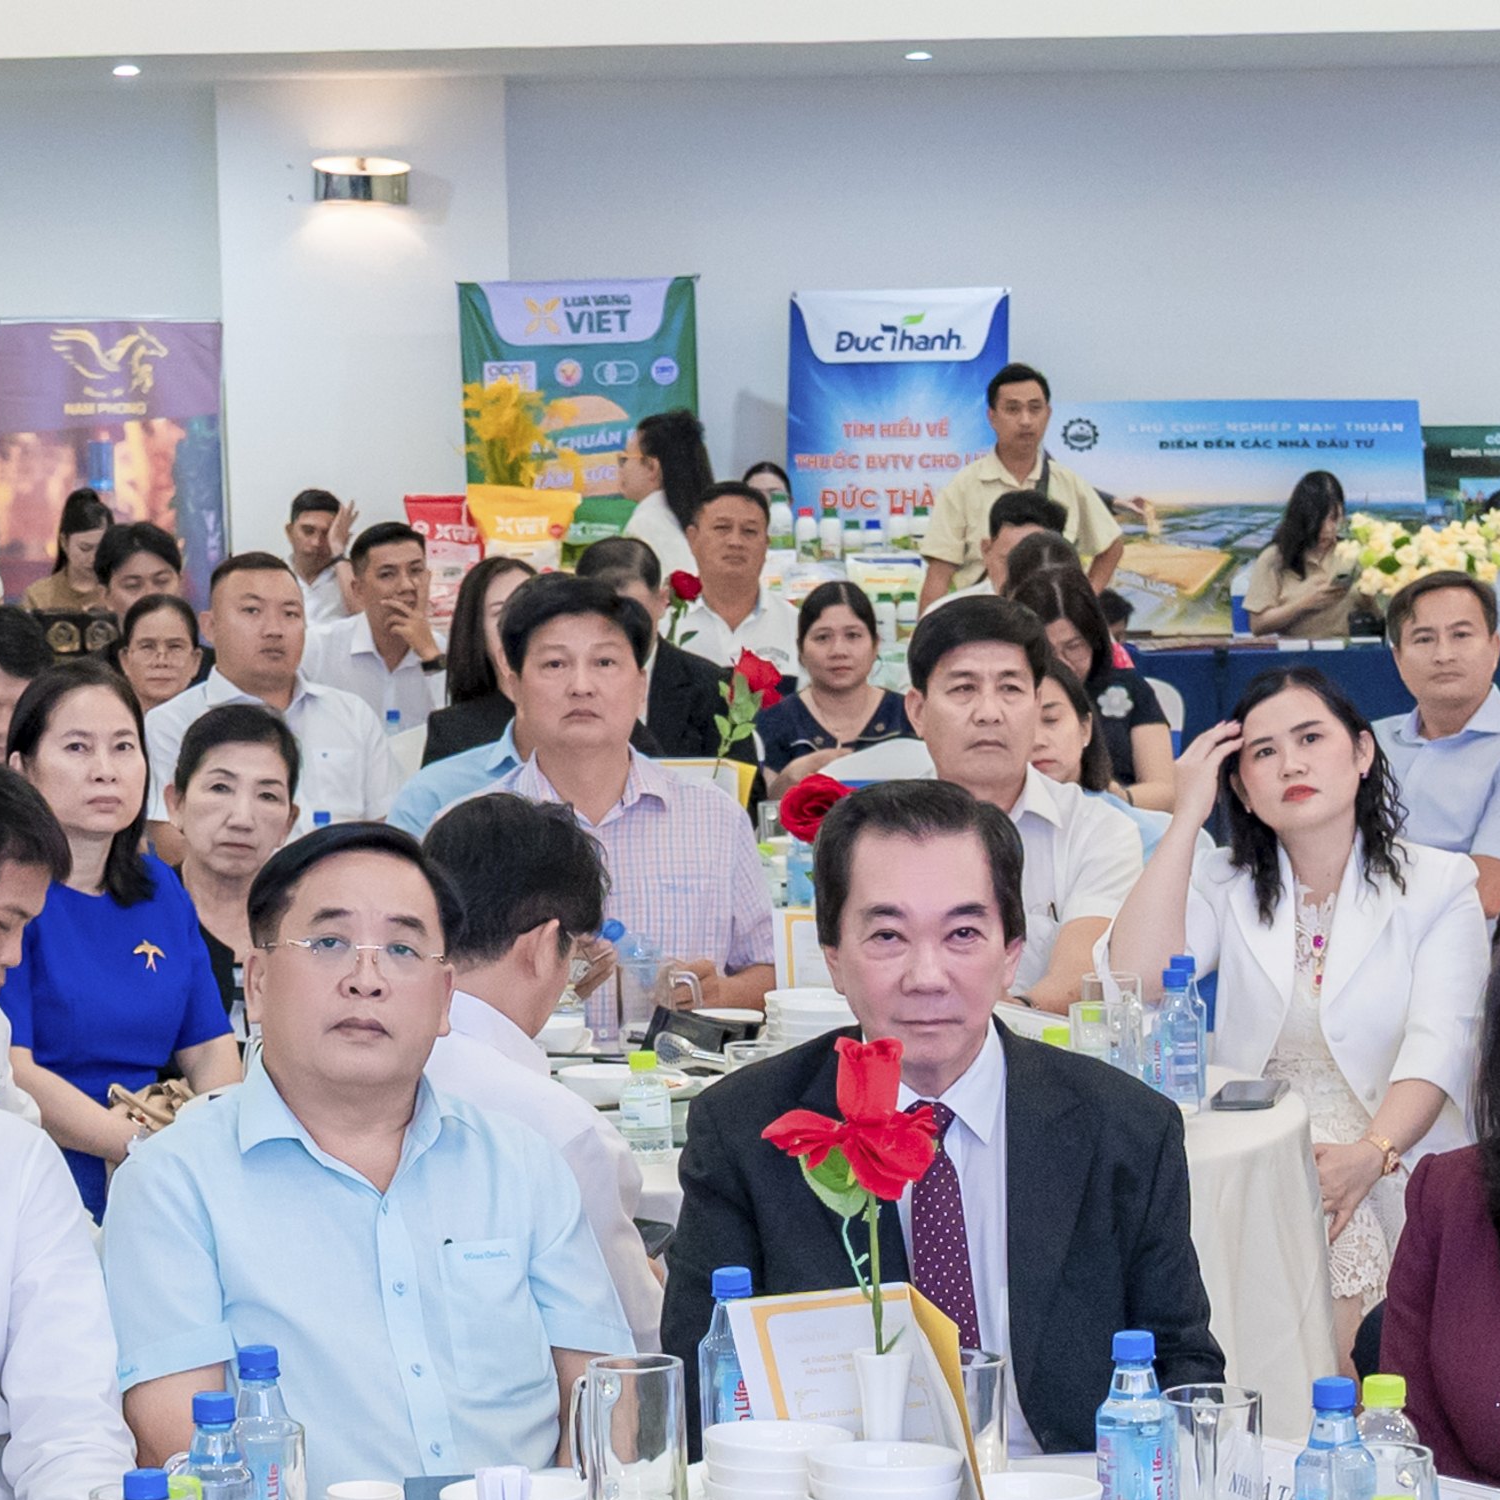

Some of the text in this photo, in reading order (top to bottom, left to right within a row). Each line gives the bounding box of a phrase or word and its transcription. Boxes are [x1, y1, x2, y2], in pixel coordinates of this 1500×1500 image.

[564, 309, 631, 334] VIET
[1240, 436, 1273, 450] CÁC
[918, 452, 960, 470] CHO
[820, 483, 935, 509] ĐỨC THÀ
